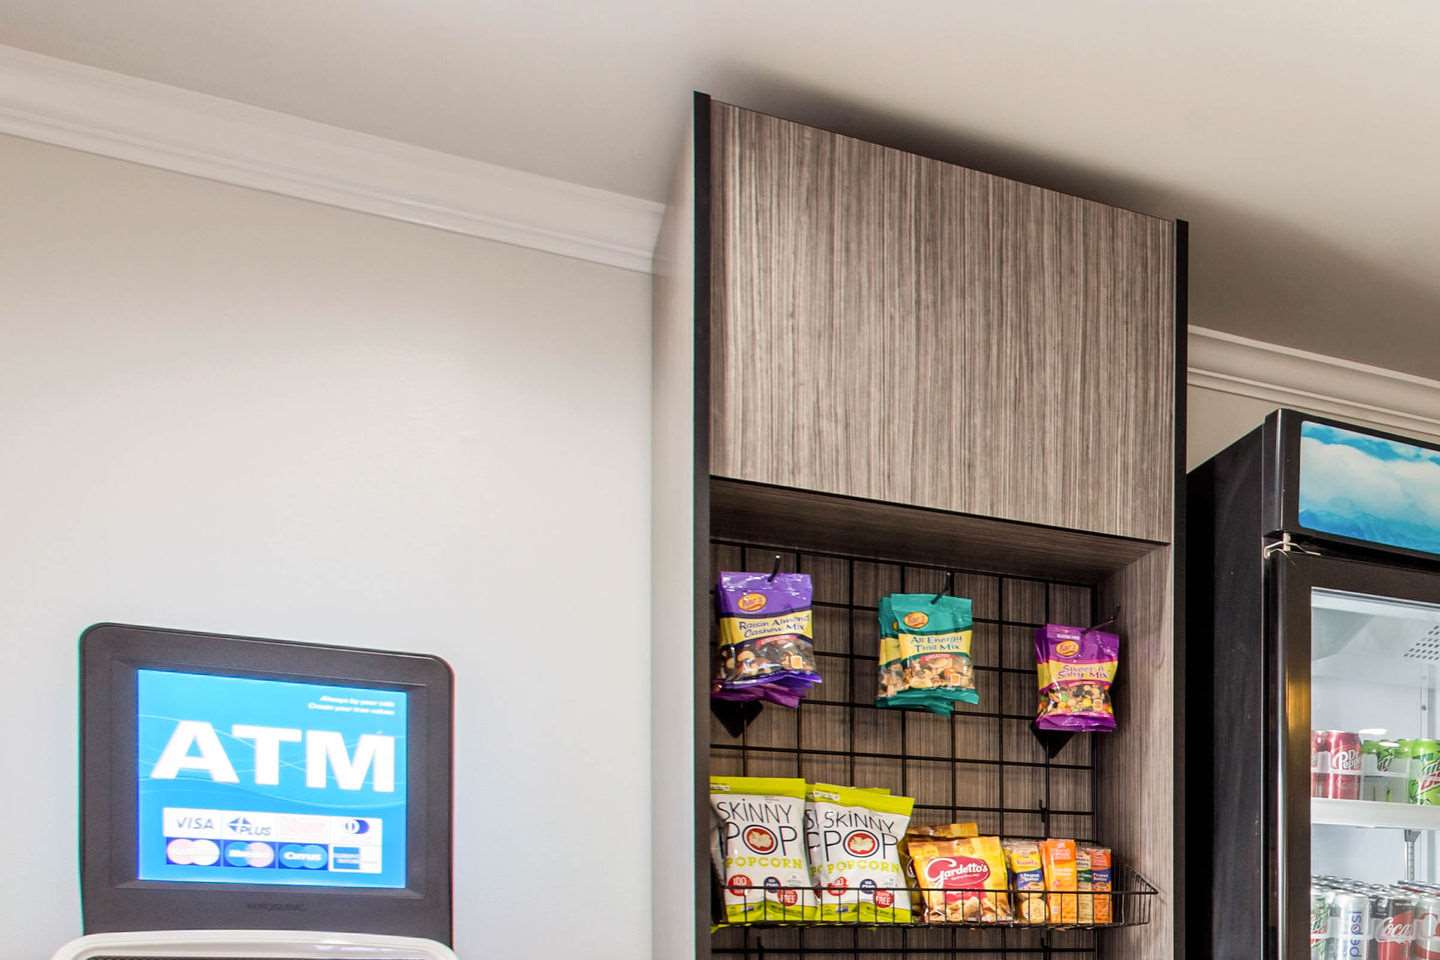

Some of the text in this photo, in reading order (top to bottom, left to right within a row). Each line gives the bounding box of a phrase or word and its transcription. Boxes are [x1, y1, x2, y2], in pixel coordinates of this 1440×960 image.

[785, 622, 805, 631] Mix
[1088, 671, 1108, 679] Mix
[150, 719, 396, 793] ATM
[176, 817, 215, 830] VISA
[239, 825, 272, 836] PLUS
[725, 821, 798, 857] POP
[823, 829, 898, 862] POP
[725, 856, 804, 869] POPCORN
[827, 859, 902, 874] POPCORN
[925, 857, 989, 888] Gardetto's
[1349, 911, 1363, 958] pepsi
